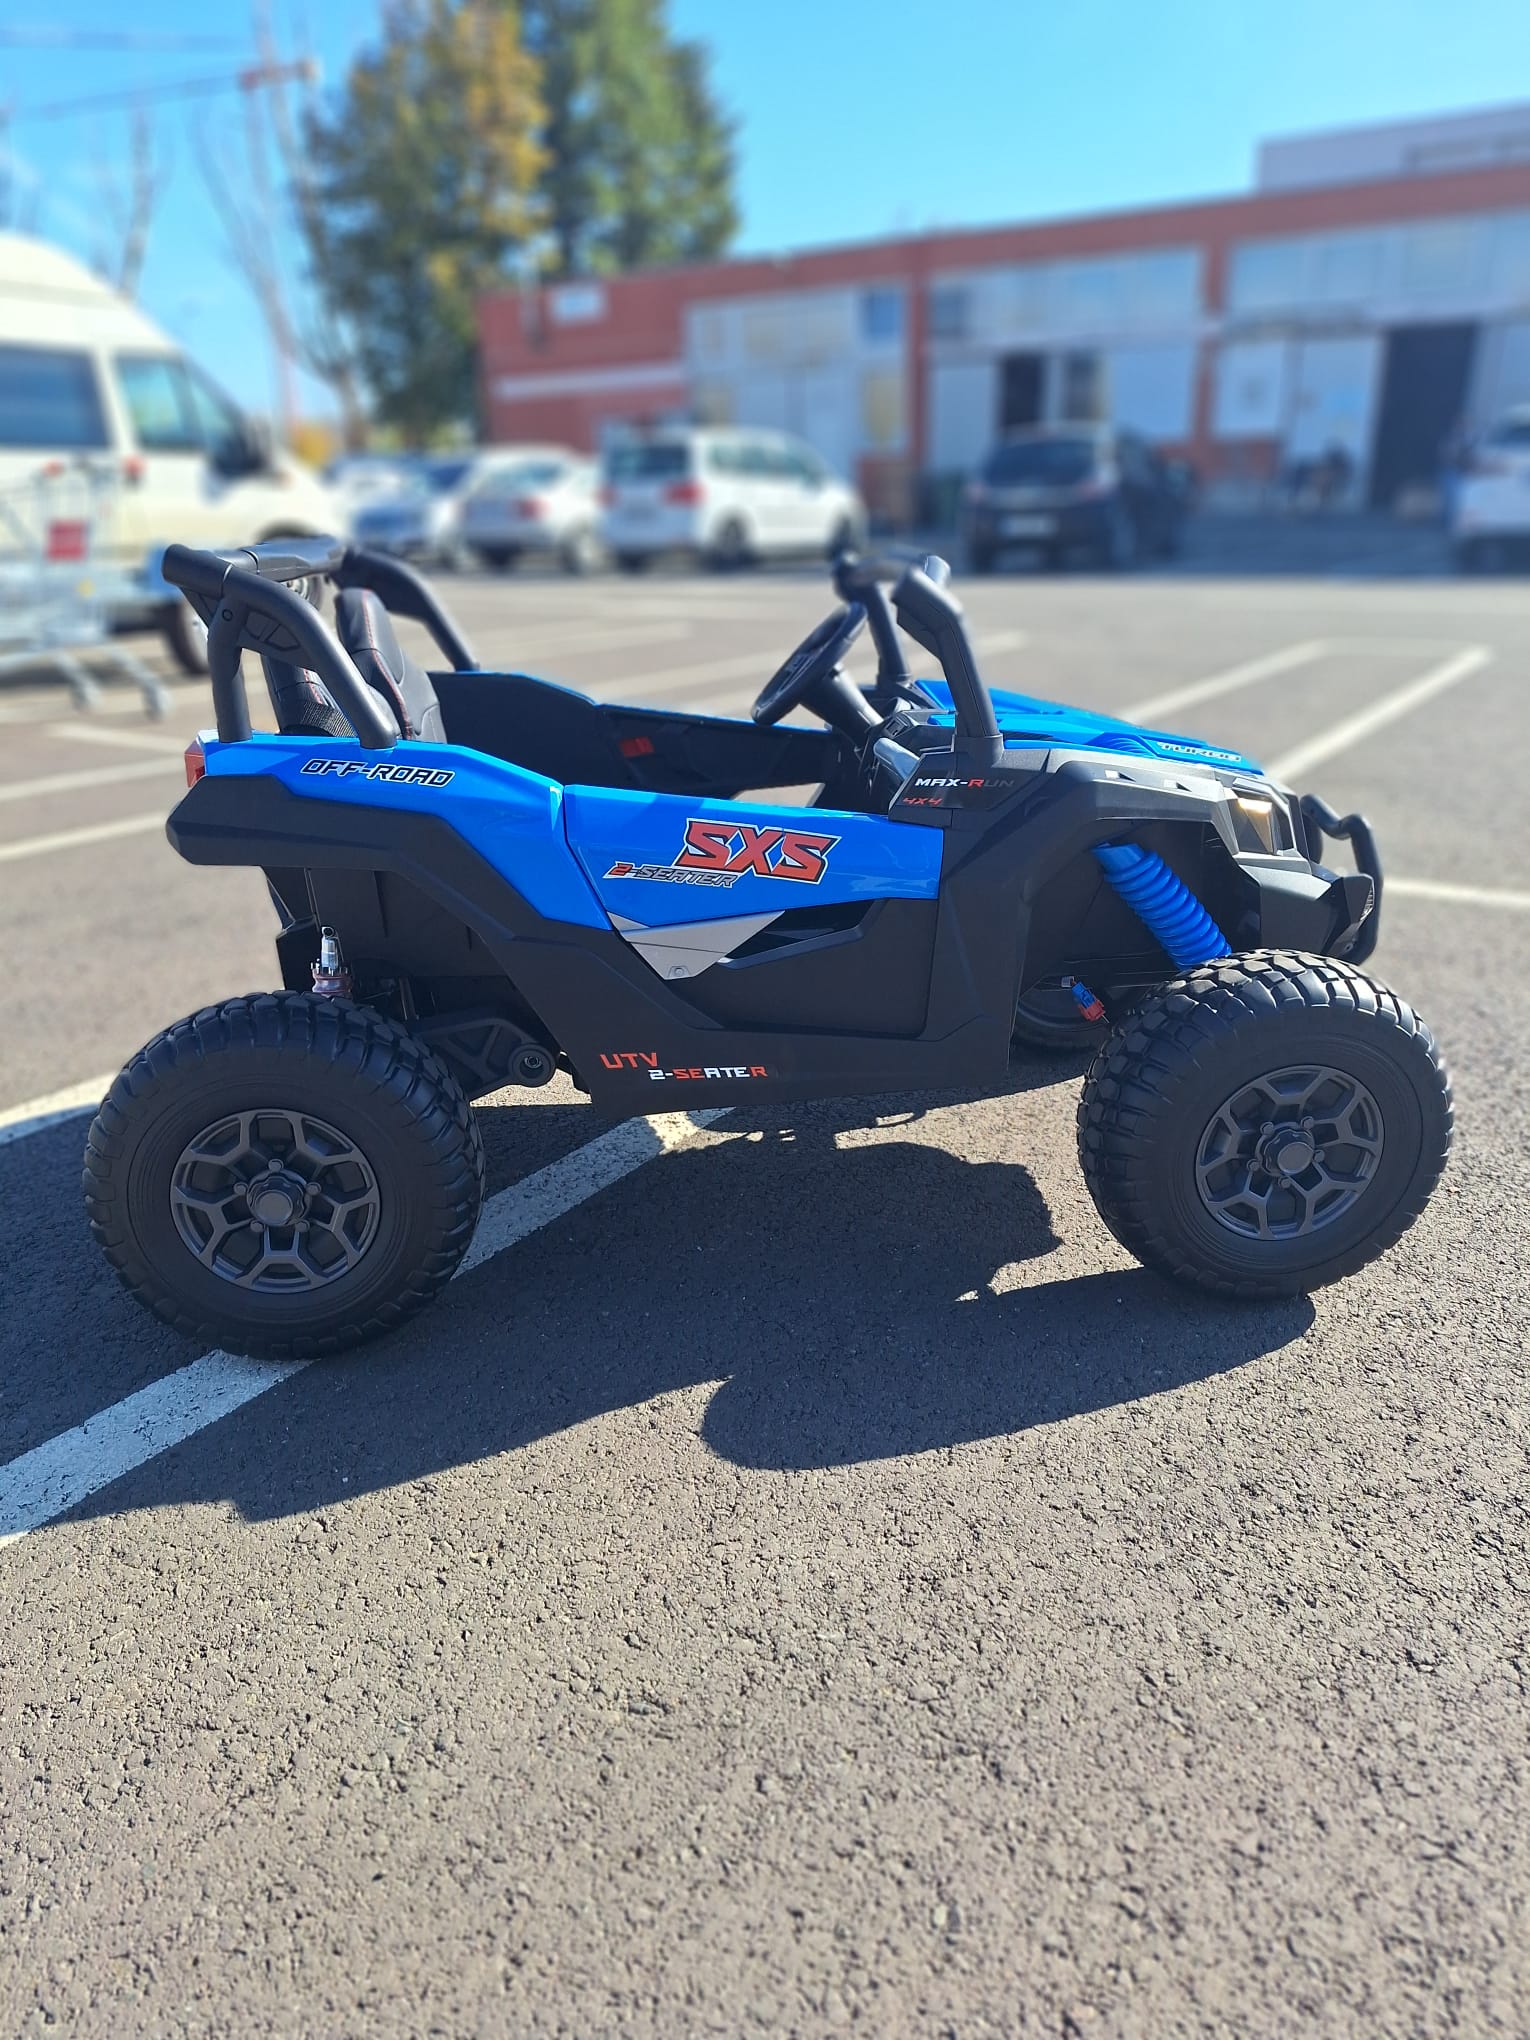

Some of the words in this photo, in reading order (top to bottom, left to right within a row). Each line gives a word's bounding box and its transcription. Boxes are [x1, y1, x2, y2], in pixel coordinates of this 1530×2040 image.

[301, 758, 456, 788] OFF-ROAD
[914, 778, 1015, 788] MAX-RUN
[674, 819, 841, 885] SXS
[604, 862, 741, 888] 2-SEATER
[600, 1052, 658, 1069] UTV
[648, 1066, 768, 1080] 2-SEATER
